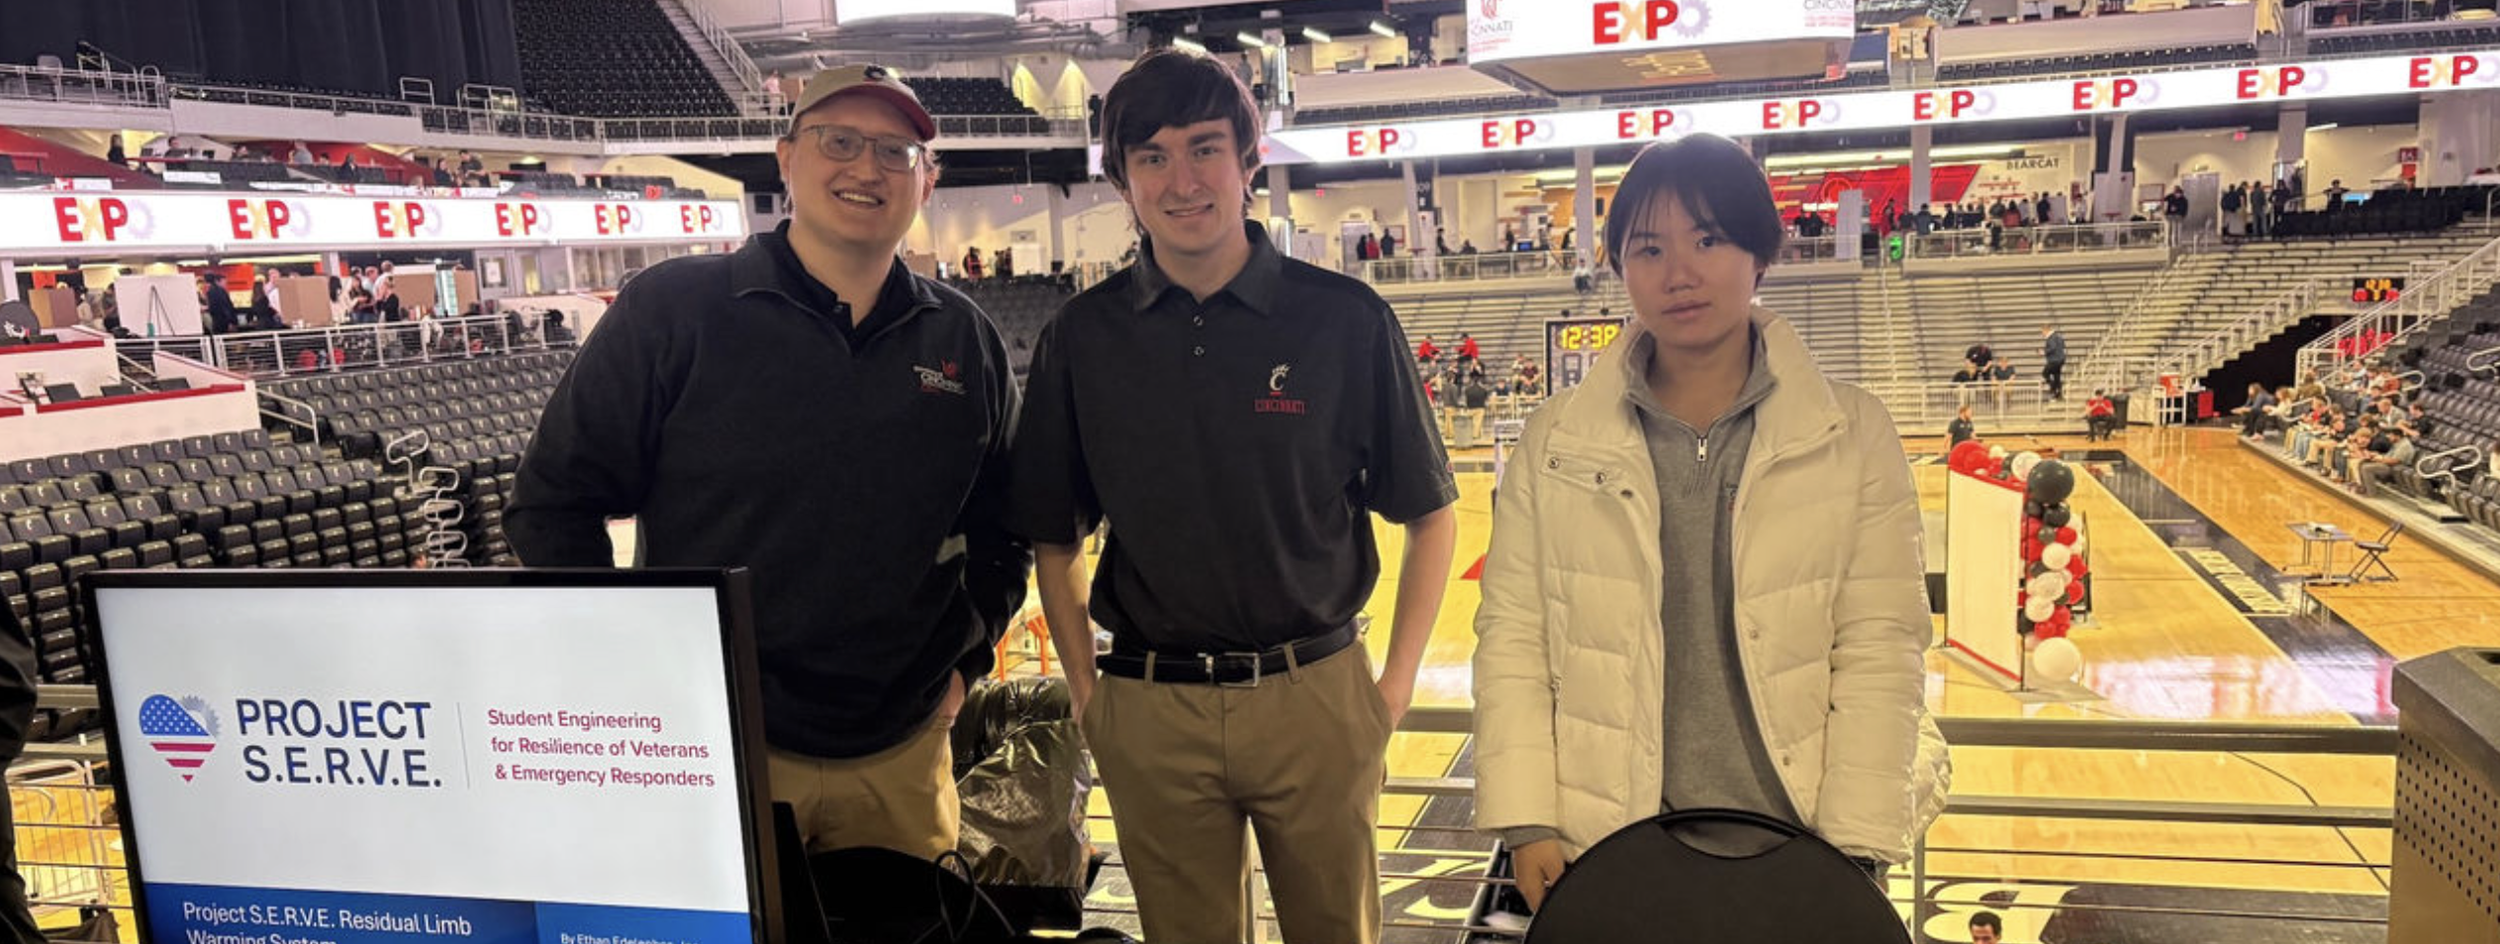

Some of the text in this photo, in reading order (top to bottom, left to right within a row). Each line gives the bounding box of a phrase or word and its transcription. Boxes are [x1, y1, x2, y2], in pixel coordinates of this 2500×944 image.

[235, 699, 431, 740] PROJECT
[488, 709, 662, 733] Student Engineering
[491, 737, 709, 758] for Resilience of Veterans
[243, 745, 442, 787] S.E.R.V.E.
[495, 764, 715, 787] & Emergency Responders
[183, 902, 472, 936] Project S.E.R.V.E. Residual Limb
